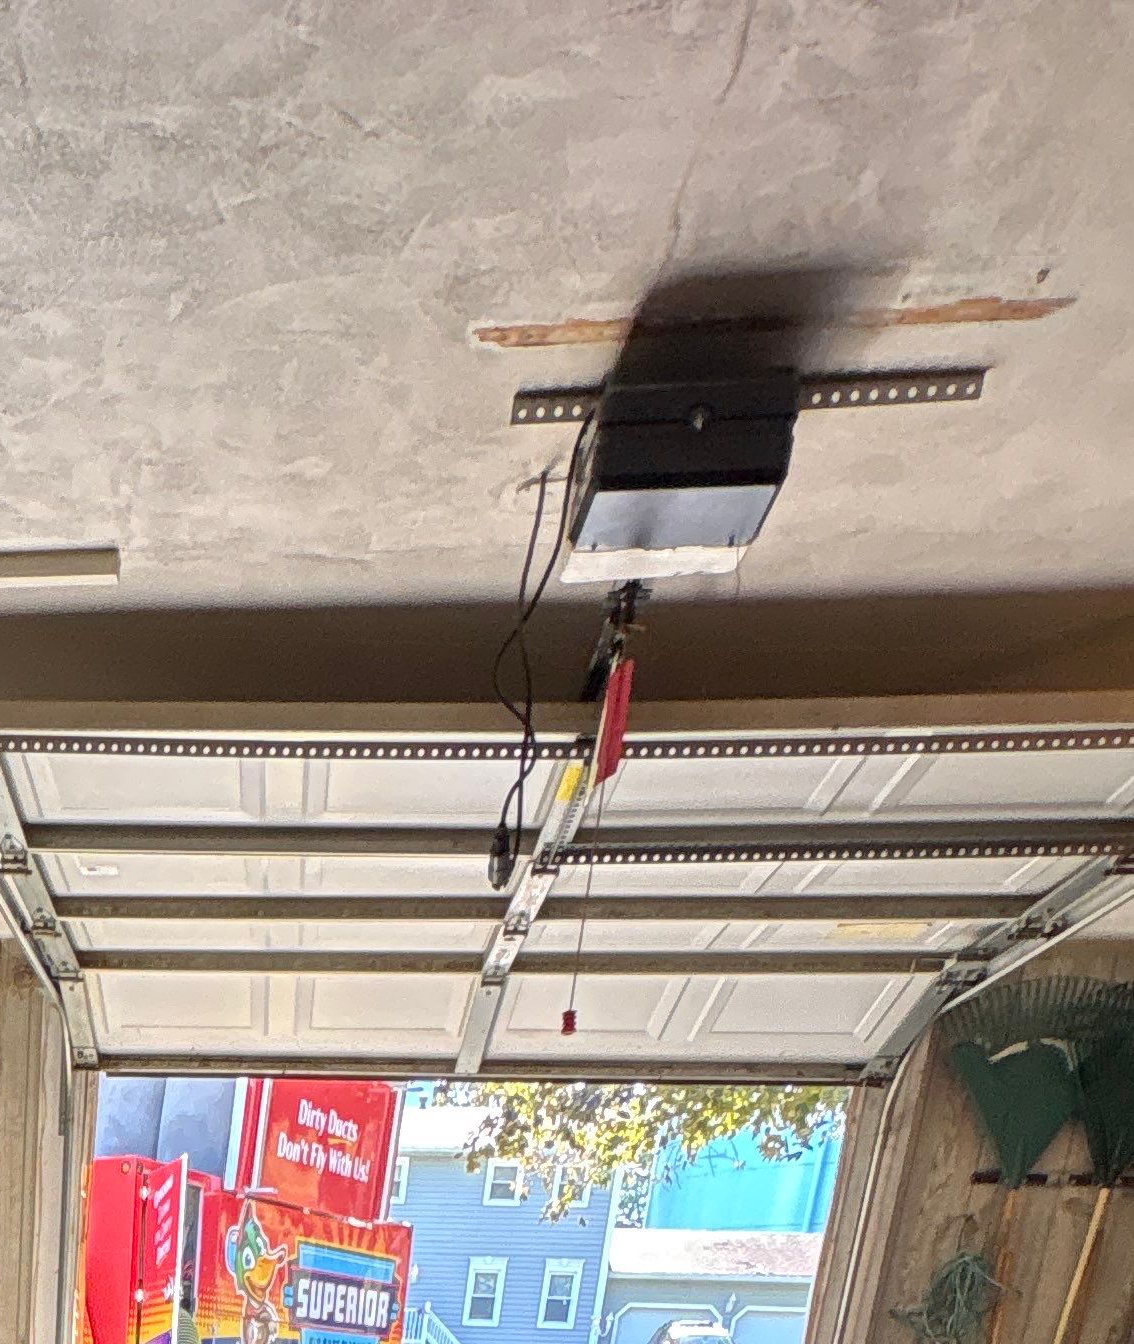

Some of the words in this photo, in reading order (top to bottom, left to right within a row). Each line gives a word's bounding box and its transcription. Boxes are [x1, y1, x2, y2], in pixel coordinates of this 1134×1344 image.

[297, 1098, 327, 1136] Dirty
[327, 1109, 359, 1142] Ducts
[277, 1132, 309, 1166] Don't
[310, 1142, 327, 1175] Fly
[328, 1147, 352, 1178] With
[353, 1156, 371, 1183] Us!
[295, 1278, 391, 1329] SUPERIOR
